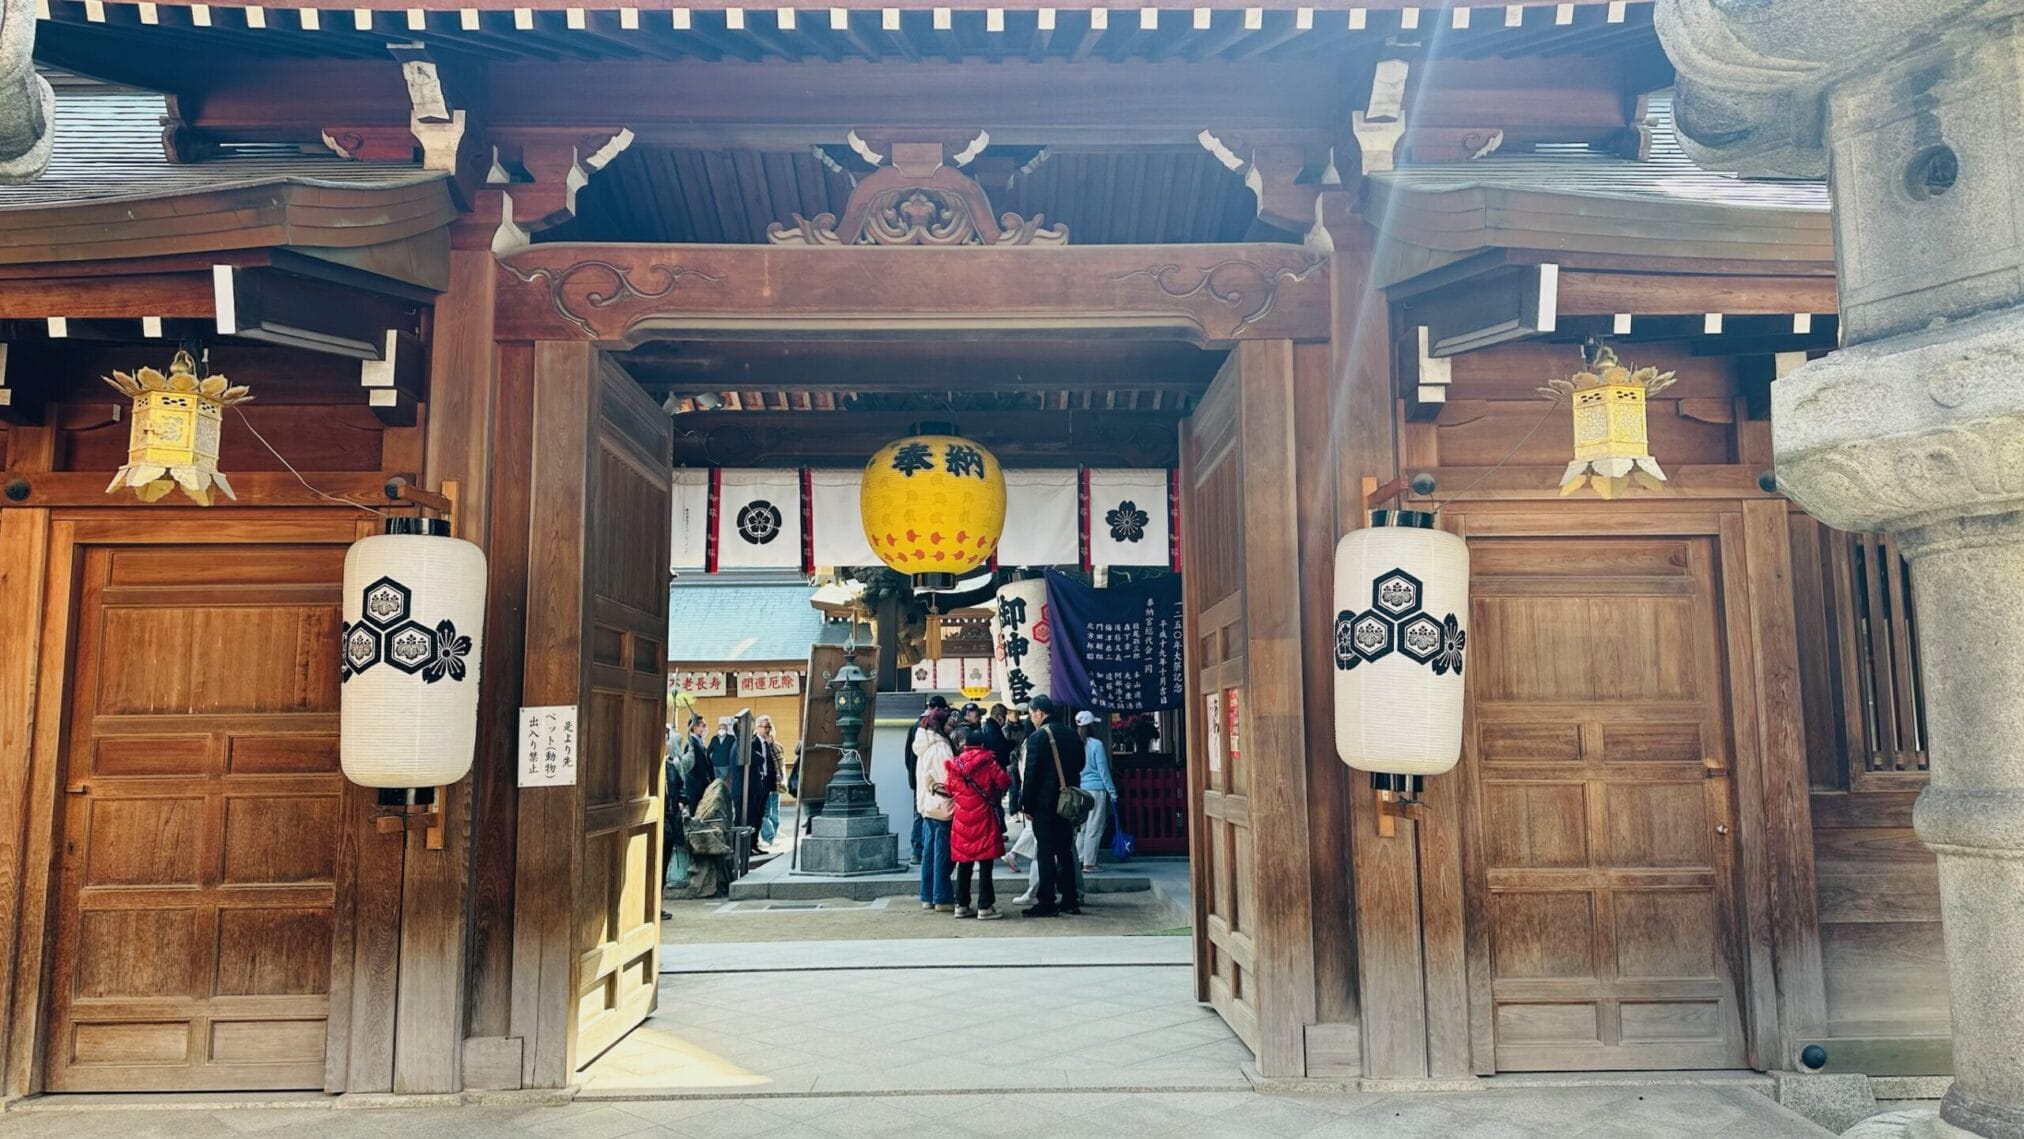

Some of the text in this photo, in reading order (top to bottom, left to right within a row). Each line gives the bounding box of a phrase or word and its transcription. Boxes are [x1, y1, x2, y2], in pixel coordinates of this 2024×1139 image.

[892, 443, 985, 479] 奉納
[741, 675, 794, 690] 開運厄除
[1159, 620, 1167, 704] 平成十九年十月吉日
[528, 716, 540, 774] 出入り禁止
[563, 721, 573, 767] 是より先
